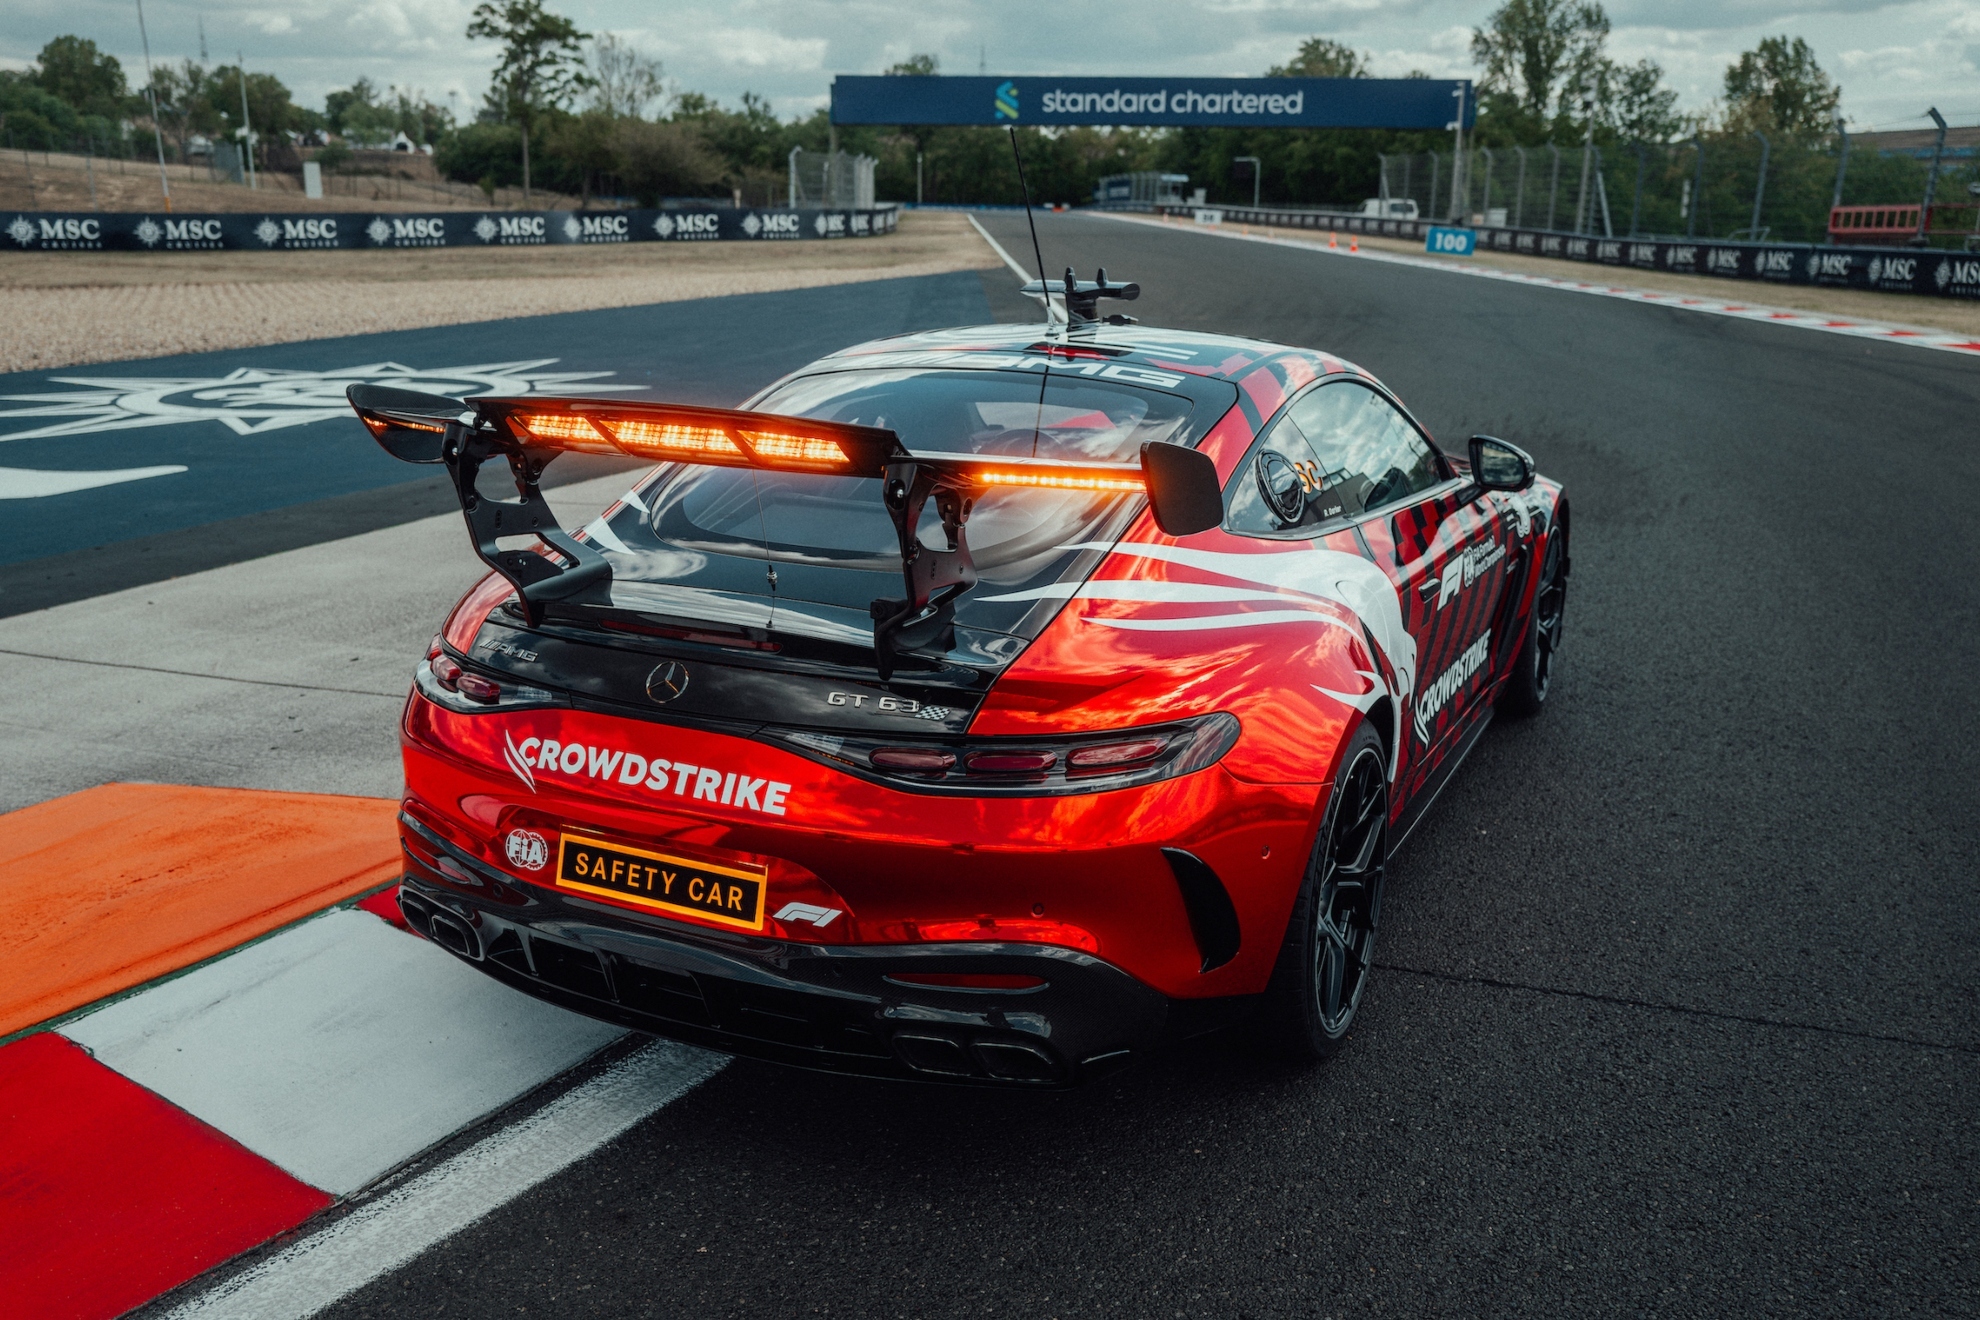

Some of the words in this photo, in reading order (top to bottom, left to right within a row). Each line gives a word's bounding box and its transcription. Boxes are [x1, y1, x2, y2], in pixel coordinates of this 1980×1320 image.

[1042, 89, 1167, 113] standard
[1170, 89, 1304, 114] chartered
[38, 218, 101, 240] MSC
[164, 219, 222, 240] MSC
[282, 218, 337, 239] MSC
[392, 218, 445, 238] MSC
[499, 216, 546, 236] MSC
[582, 215, 628, 235] MSC
[675, 214, 719, 232] MSC
[762, 214, 799, 232] MSC
[1435, 232, 1468, 252] 100
[1765, 250, 1794, 272] MSC
[1820, 254, 1852, 275] MSC
[1882, 257, 1917, 280] MSC
[1952, 261, 1980, 285] MS
[1294, 459, 1323, 494] SC
[493, 642, 539, 662] AMG
[1420, 628, 1491, 725] CROWDSTRIKE
[827, 691, 869, 708] GT
[878, 696, 919, 713] 63
[517, 737, 792, 816] CROWDSTRIKE
[575, 852, 677, 894] SAFETY
[688, 878, 743, 911] CAR
[771, 901, 843, 928] F1
